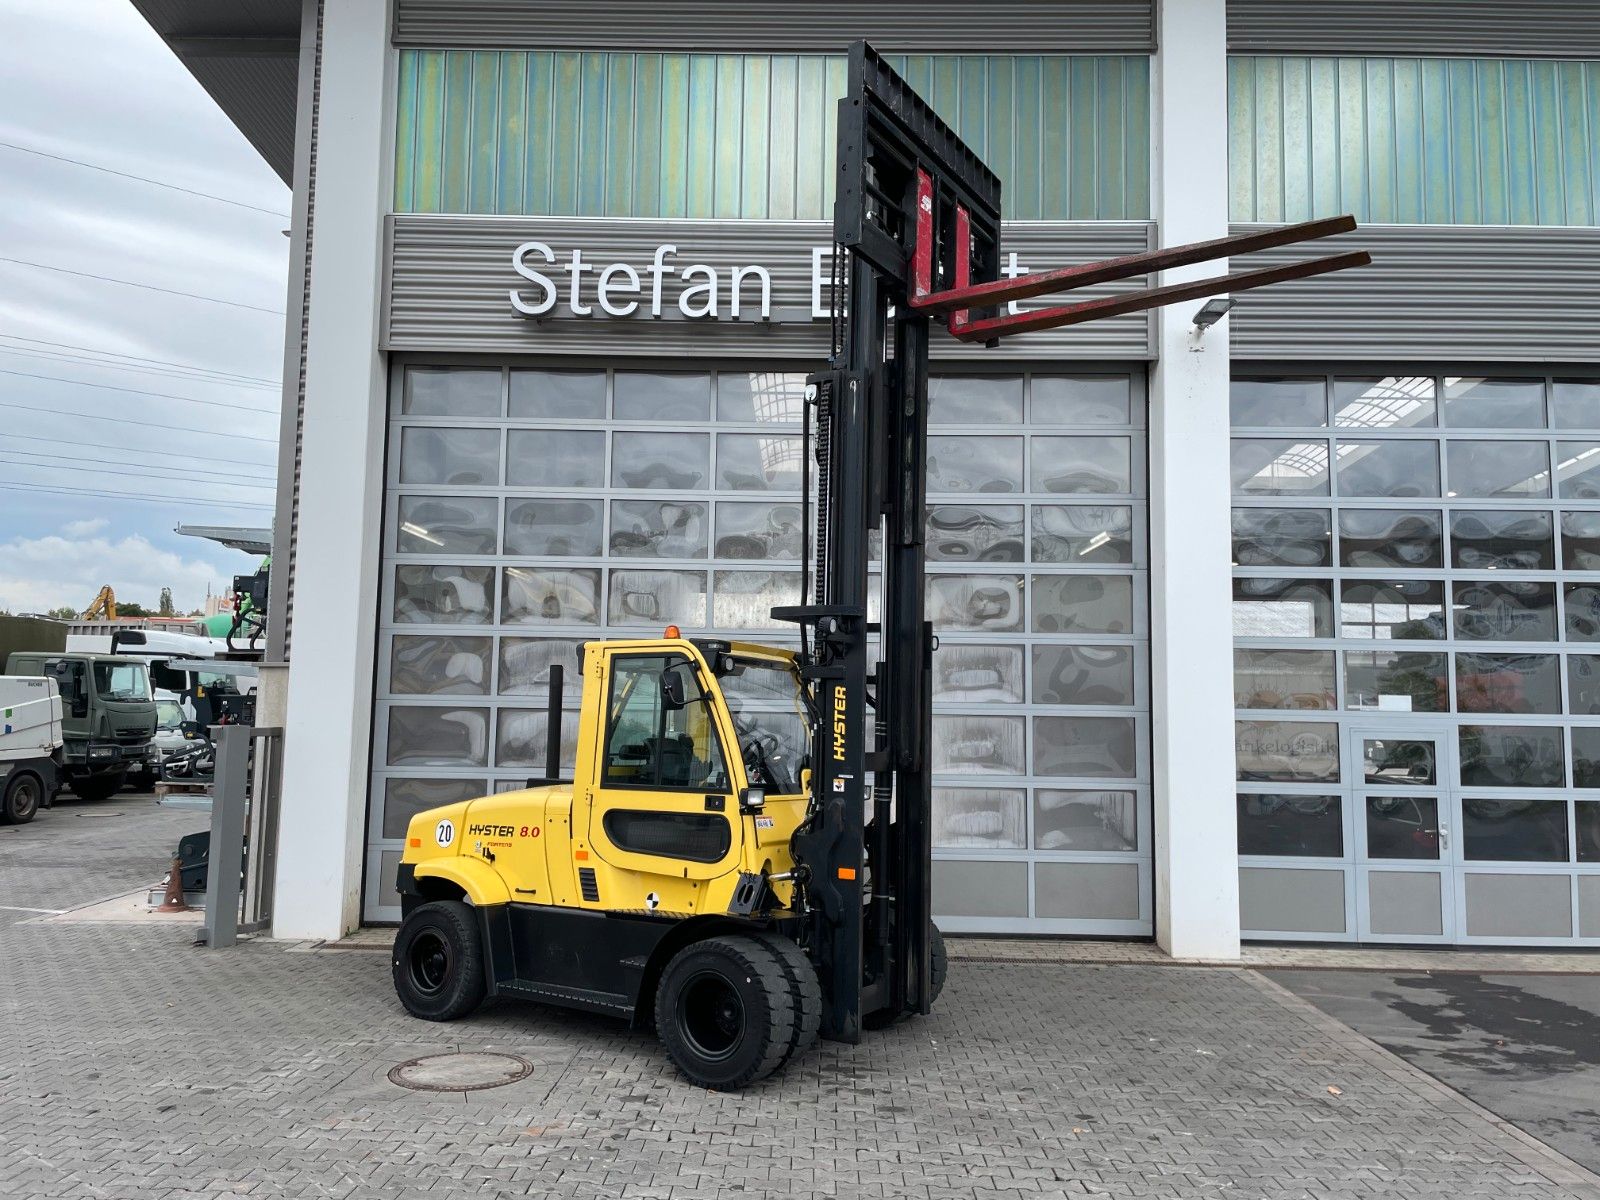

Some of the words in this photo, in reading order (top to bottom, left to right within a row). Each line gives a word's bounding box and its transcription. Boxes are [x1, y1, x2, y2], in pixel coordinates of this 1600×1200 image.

[509, 241, 771, 318] Stefan
[833, 686, 847, 761] HYSTER
[438, 824, 452, 842] 20
[469, 824, 514, 838] HYSTER
[520, 826, 540, 838] 8.0
